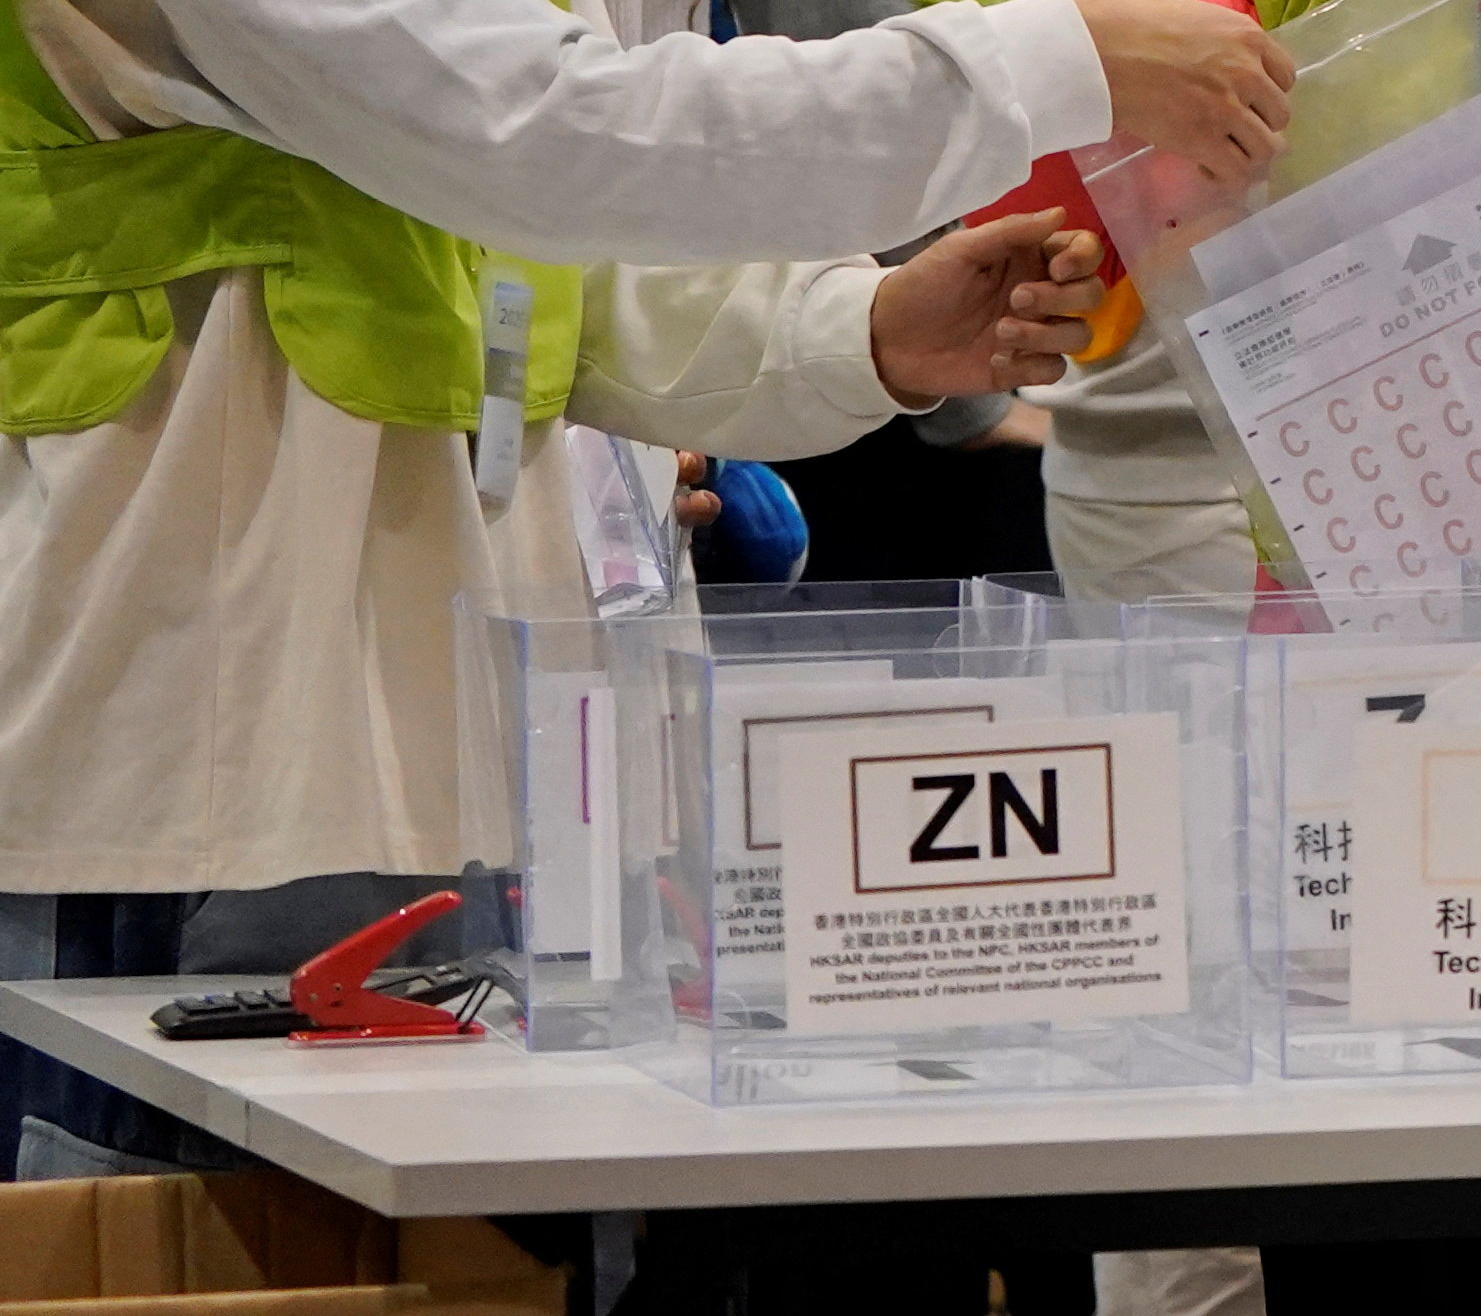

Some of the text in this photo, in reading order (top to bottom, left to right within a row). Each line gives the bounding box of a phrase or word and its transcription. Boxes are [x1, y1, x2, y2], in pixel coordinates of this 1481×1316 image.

[1379, 314, 1411, 337] DO
[1413, 288, 1459, 320] NOT
[909, 767, 1059, 864] ZN
[861, 967, 922, 983] National
[808, 986, 921, 1006] representatives
